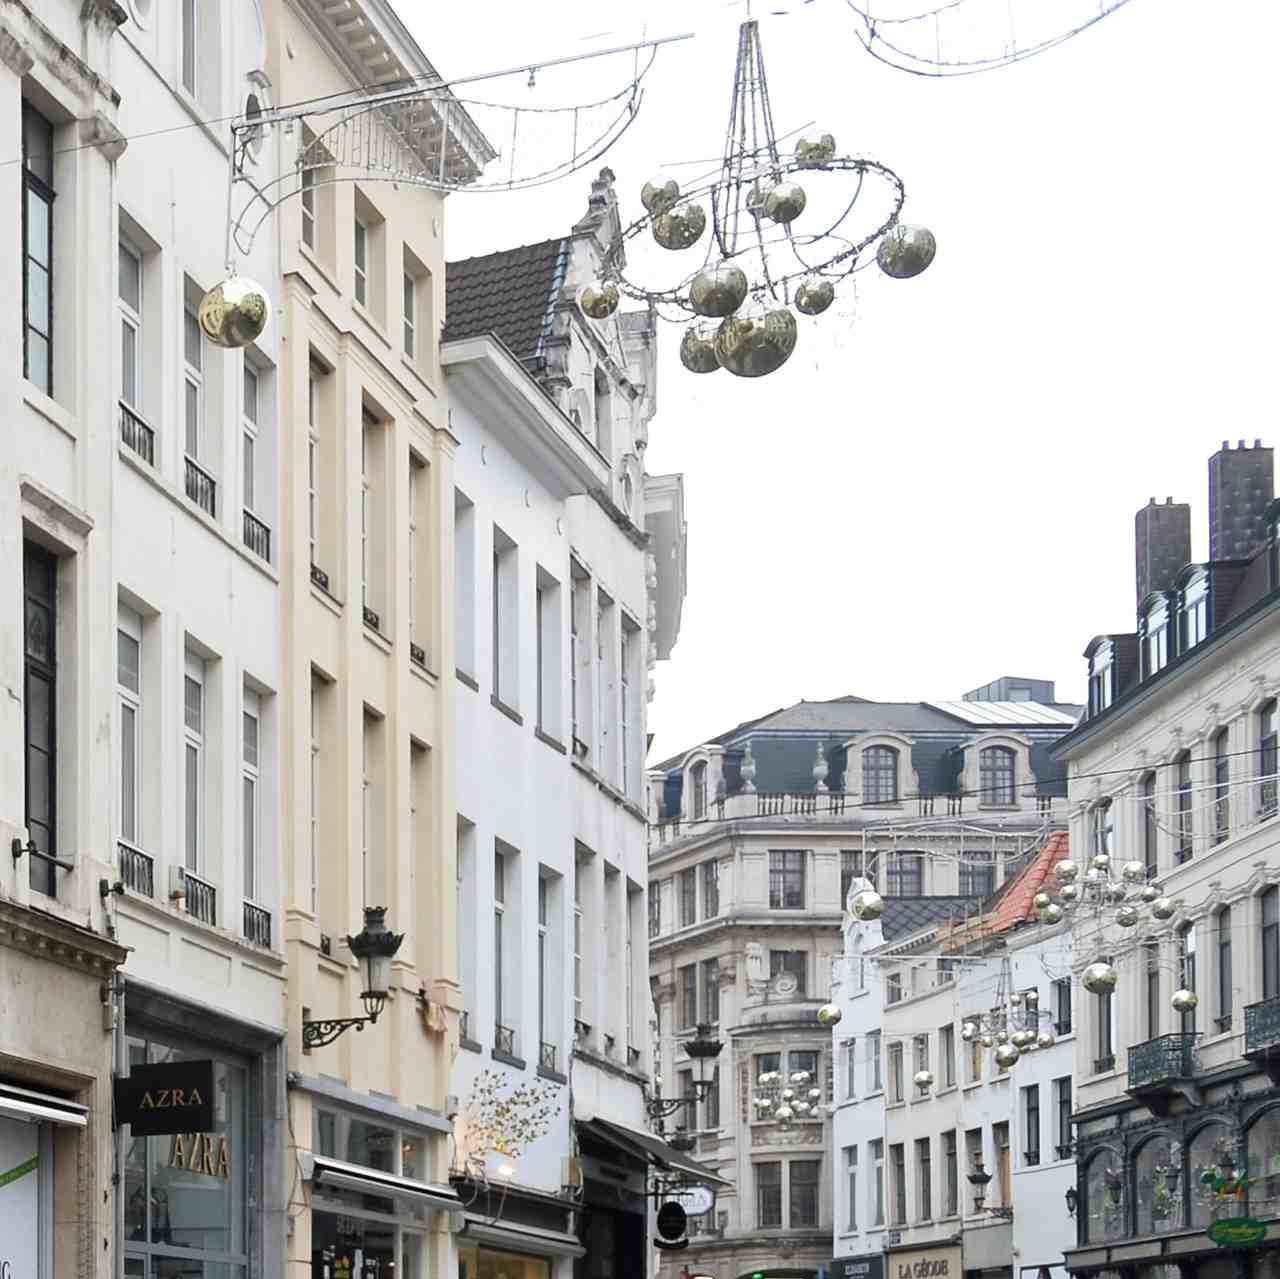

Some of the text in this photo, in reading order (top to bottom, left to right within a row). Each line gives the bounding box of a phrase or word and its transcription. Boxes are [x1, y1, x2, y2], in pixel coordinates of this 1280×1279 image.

[140, 1087, 203, 1109] AZRA
[168, 1132, 231, 1179] AZRA
[898, 1263, 913, 1279] LA
